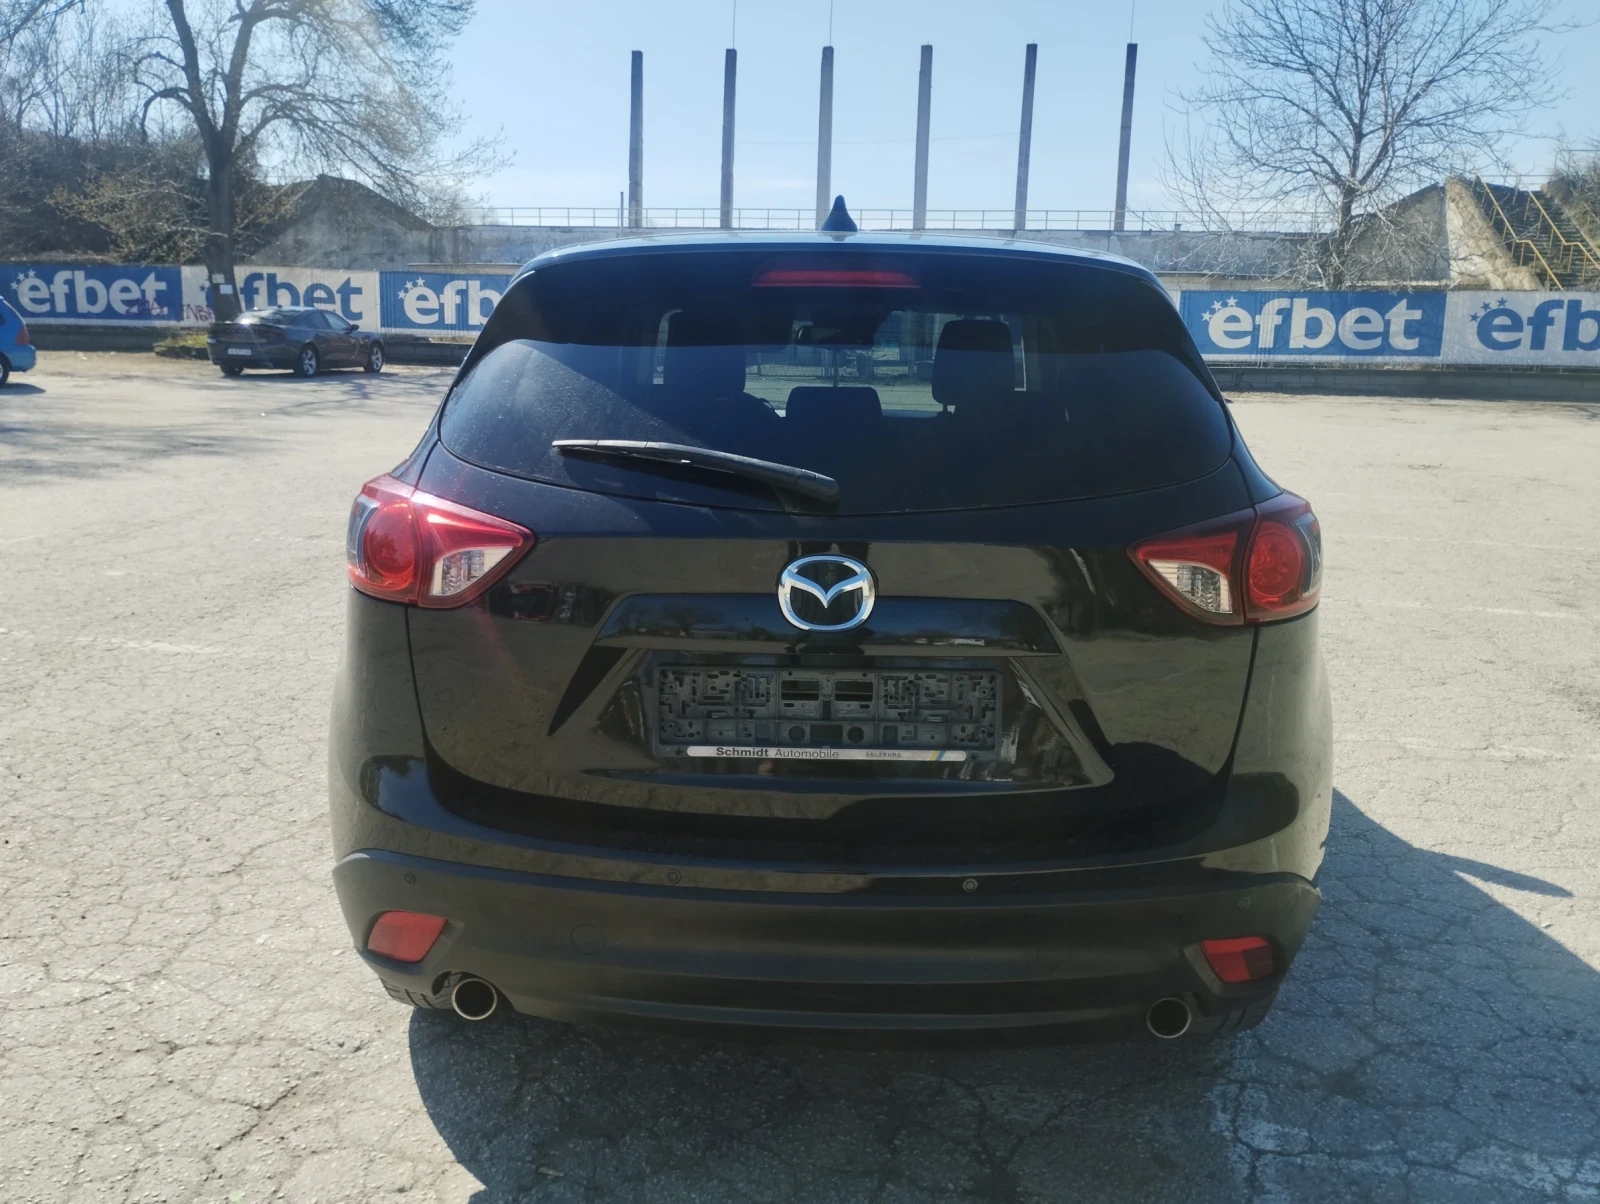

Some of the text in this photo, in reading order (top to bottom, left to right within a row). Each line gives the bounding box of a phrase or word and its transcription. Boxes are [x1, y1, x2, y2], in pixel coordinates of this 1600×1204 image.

[18, 270, 168, 316] efbet
[206, 272, 363, 321] fbet
[1208, 297, 1423, 350] efbet
[715, 747, 769, 758] Schmidt
[774, 749, 840, 759] Automobile
